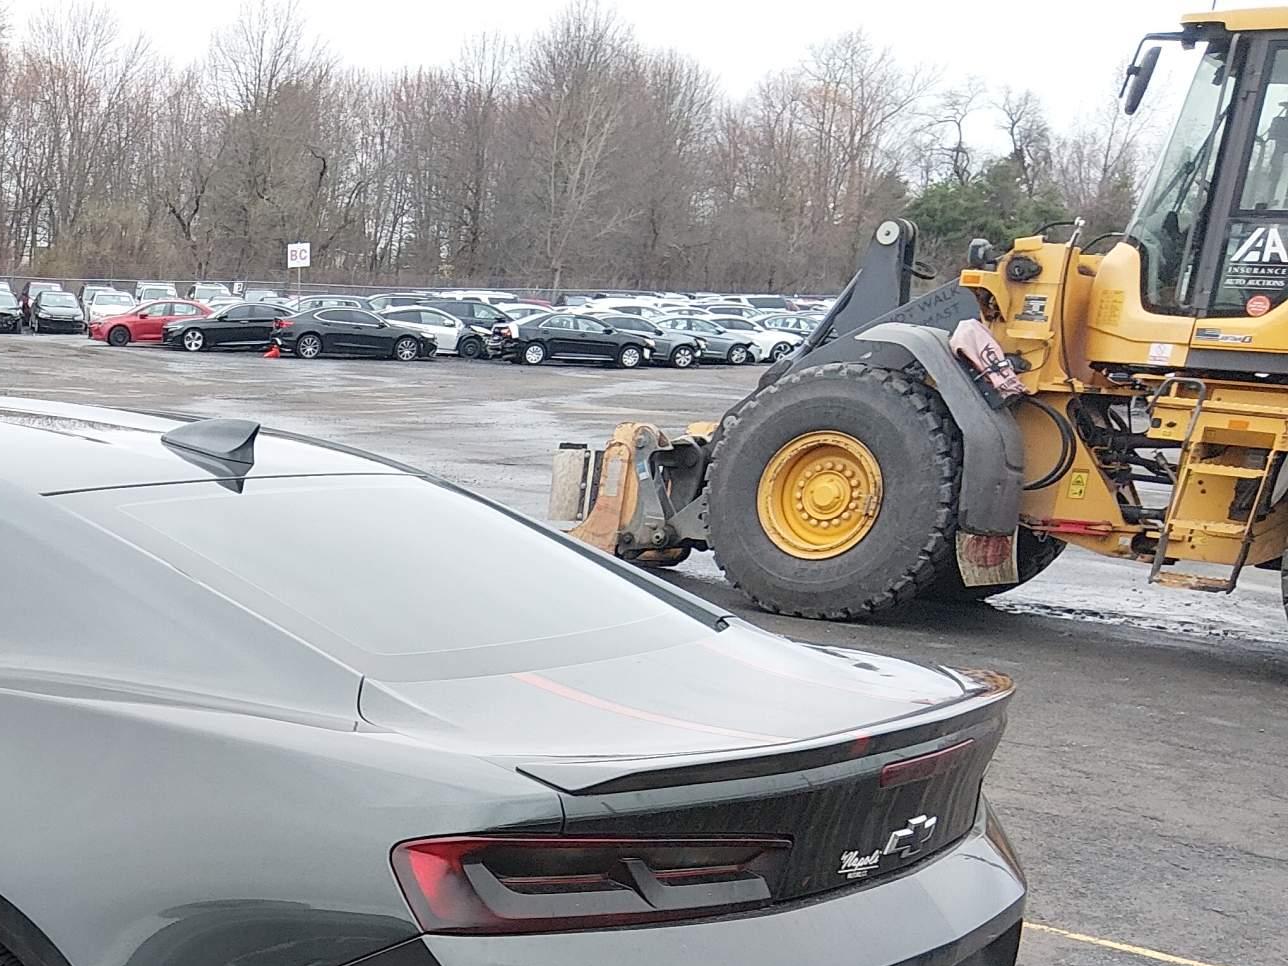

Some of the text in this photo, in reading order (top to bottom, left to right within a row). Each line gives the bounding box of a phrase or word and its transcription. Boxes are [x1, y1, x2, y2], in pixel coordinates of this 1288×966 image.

[290, 249, 308, 261] BC
[1227, 266, 1287, 275] INSURANCE
[918, 285, 961, 312] WALK
